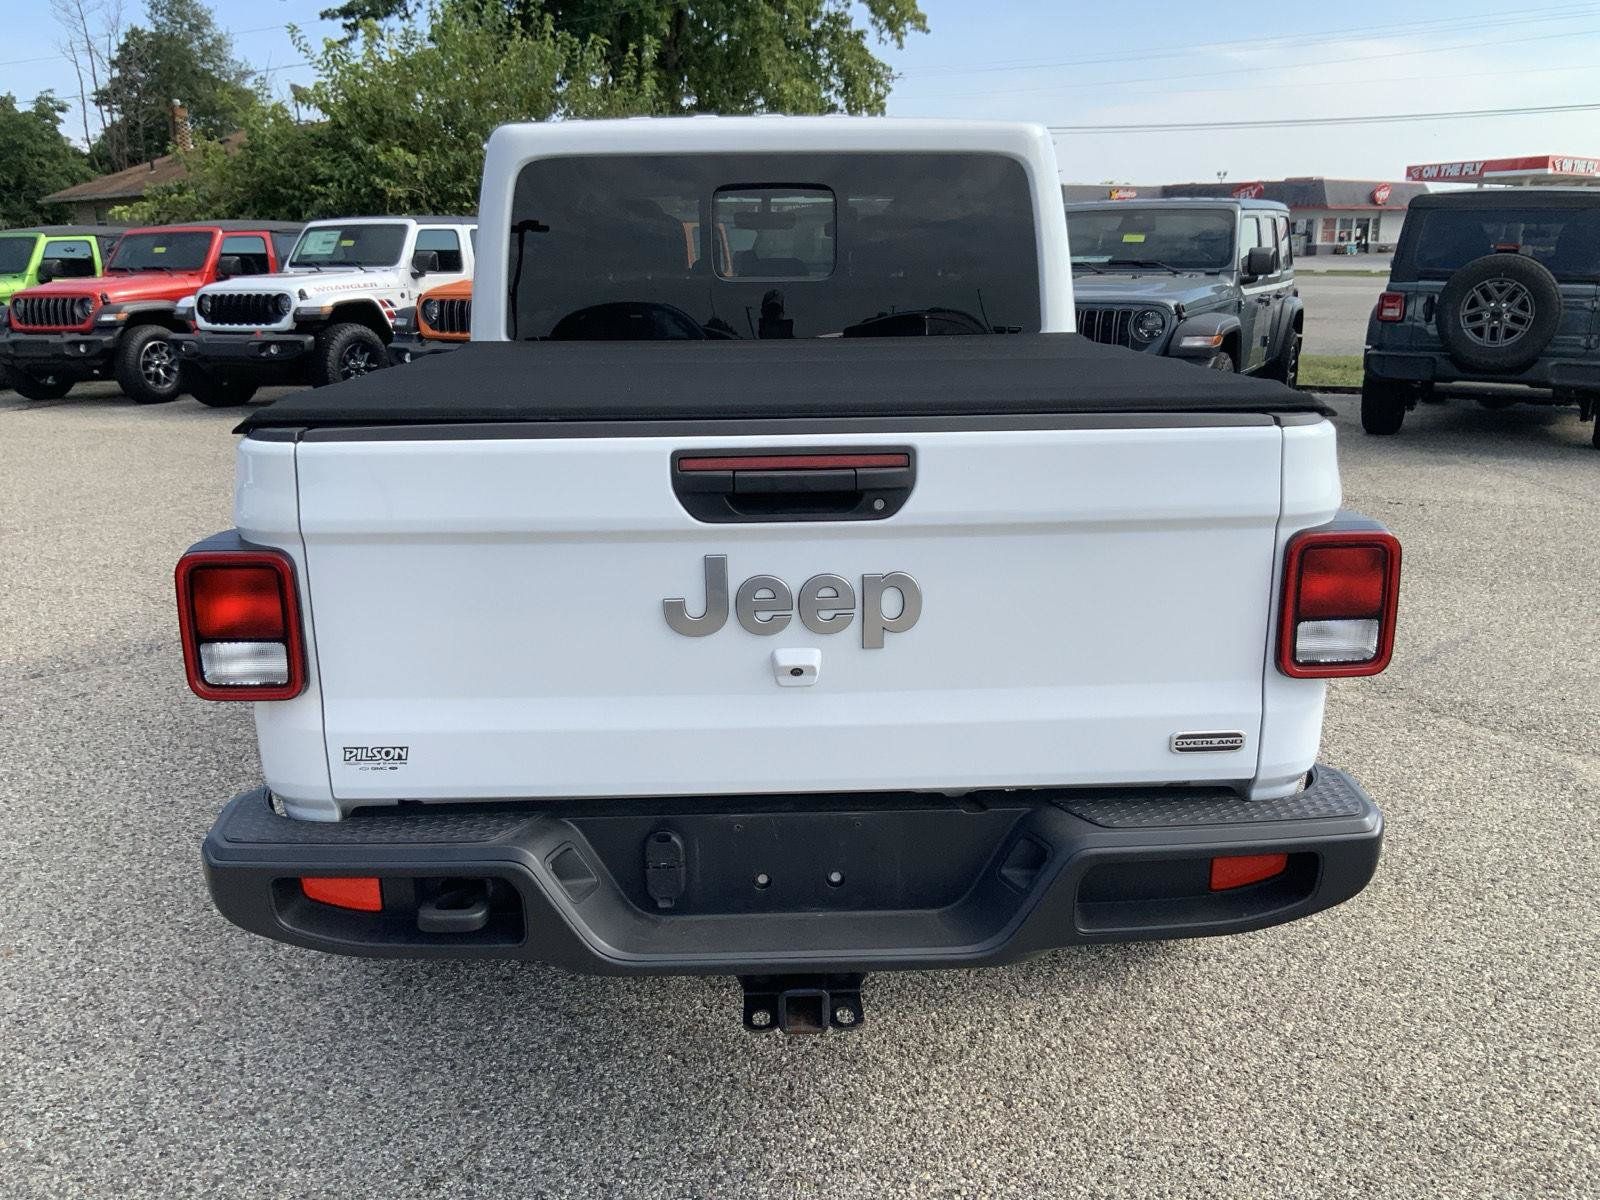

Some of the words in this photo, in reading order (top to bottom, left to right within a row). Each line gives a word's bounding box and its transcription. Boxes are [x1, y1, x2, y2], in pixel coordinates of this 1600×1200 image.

[1423, 164, 1440, 179] ON
[1440, 162, 1462, 177] THE
[1461, 161, 1485, 176] FLY
[1561, 159, 1573, 172] ON
[1573, 160, 1587, 174] THE
[314, 281, 378, 293] WRANGLER
[663, 554, 923, 649] Jeep
[1174, 738, 1243, 746] OVERLAND
[343, 746, 409, 761] PILSON
